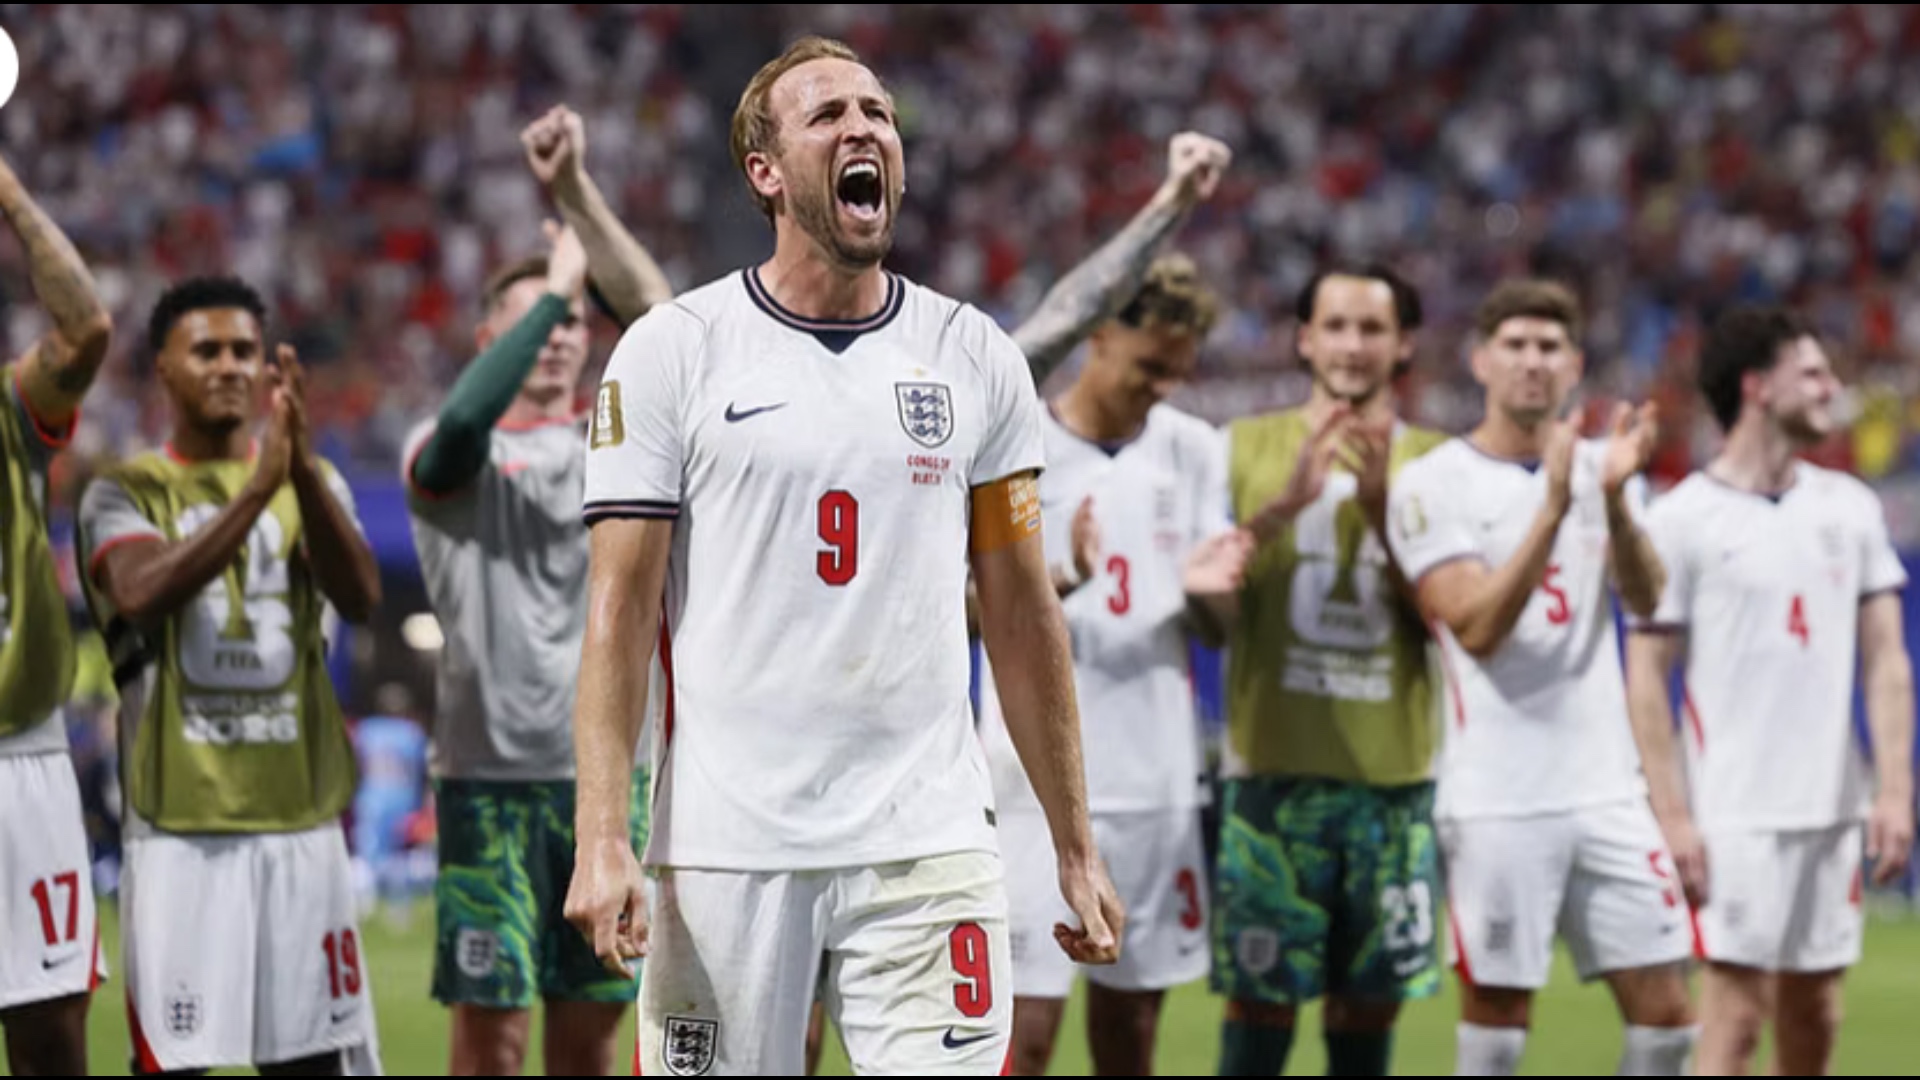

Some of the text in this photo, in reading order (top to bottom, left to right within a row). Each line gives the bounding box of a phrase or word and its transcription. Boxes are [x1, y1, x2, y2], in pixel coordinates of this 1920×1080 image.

[817, 489, 859, 586] 9
[1106, 555, 1130, 616] 3
[1543, 565, 1570, 625] 5
[1787, 593, 1809, 648] 4
[183, 713, 298, 744] 2026
[30, 870, 79, 947] 17
[1174, 867, 1202, 932] 3
[1381, 880, 1432, 951] 23
[321, 927, 361, 1000] 19
[949, 920, 992, 1018] 9
